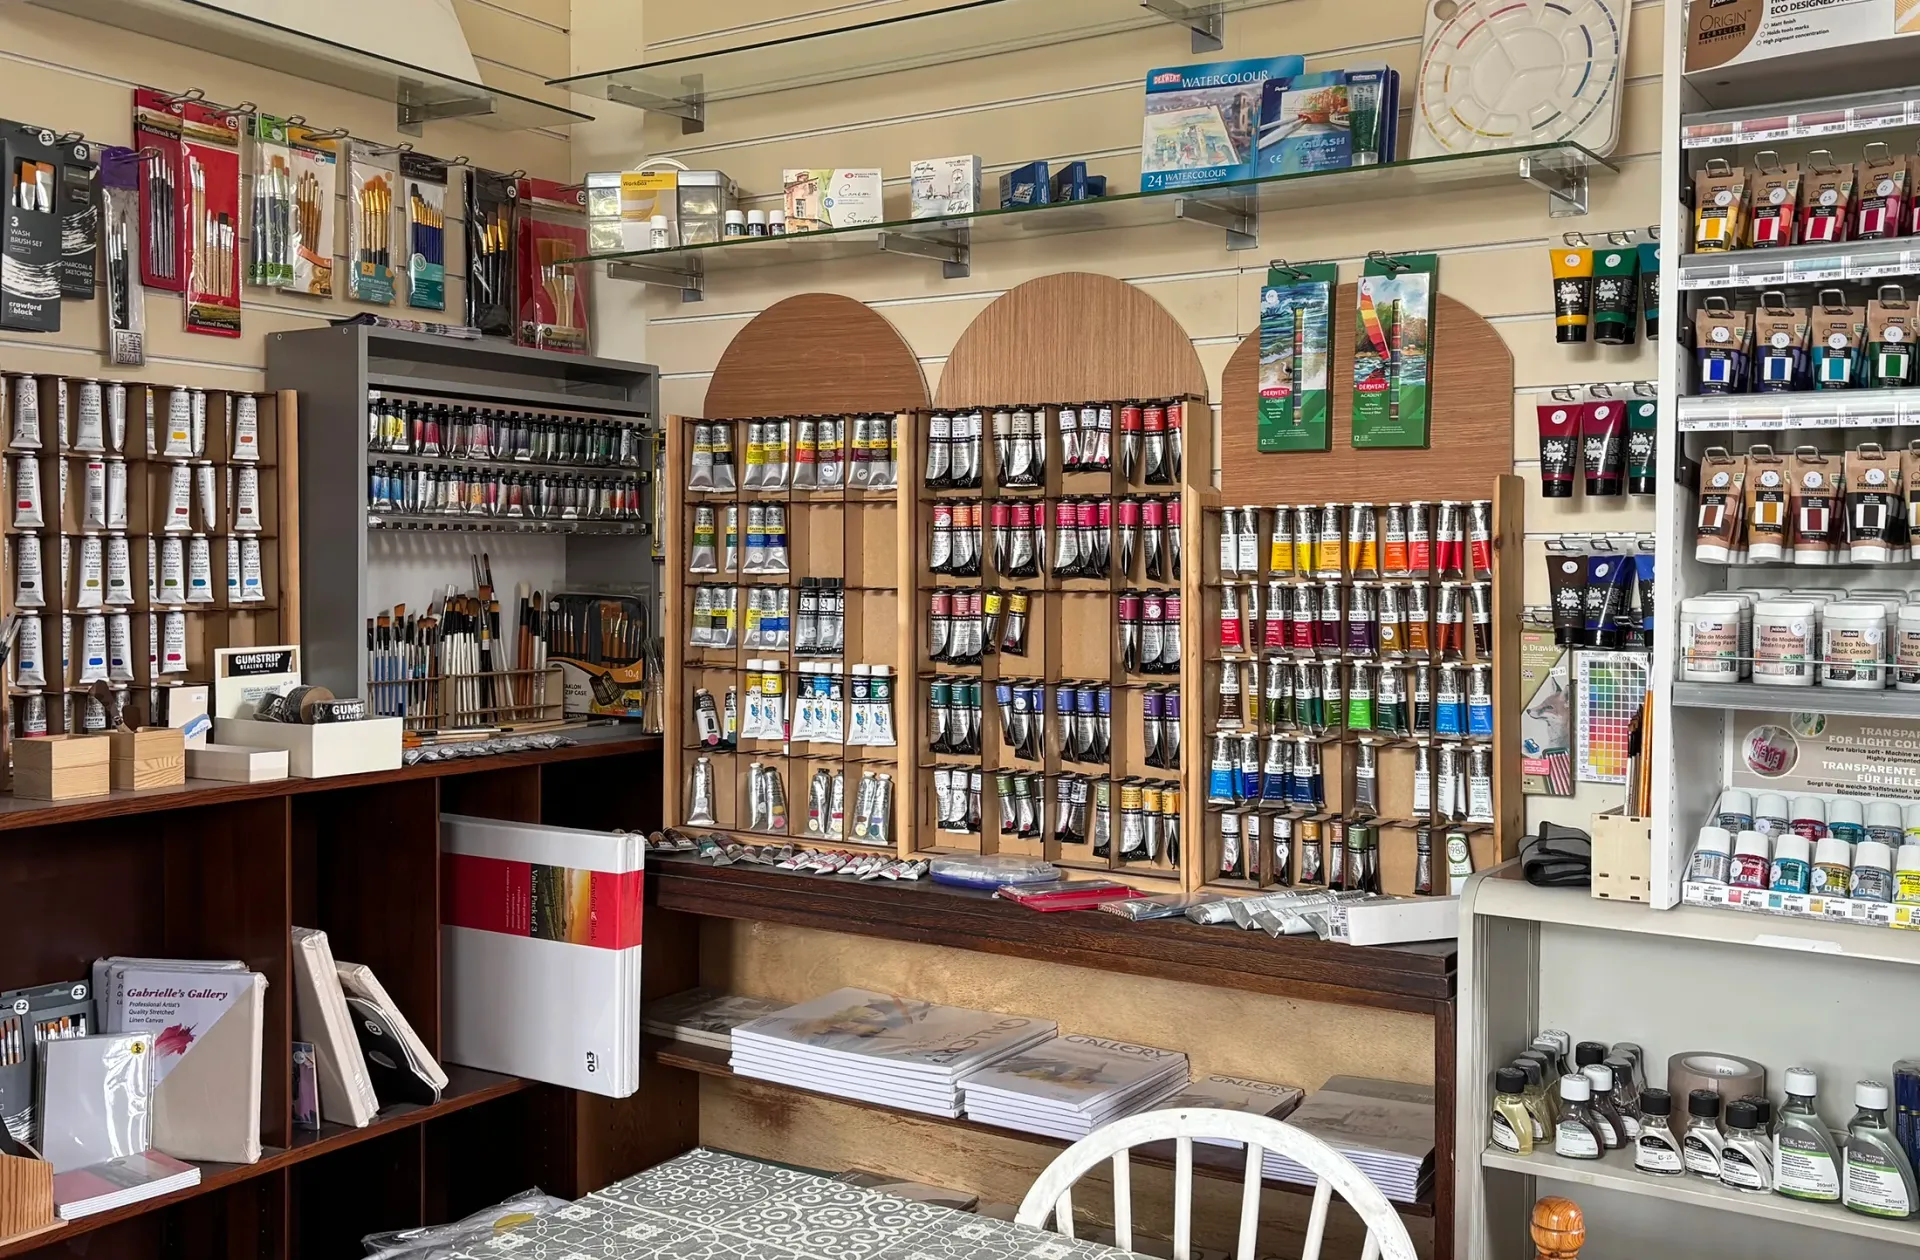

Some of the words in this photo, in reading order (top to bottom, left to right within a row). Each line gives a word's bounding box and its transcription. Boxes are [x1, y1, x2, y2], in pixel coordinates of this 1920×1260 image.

[1770, 4, 1789, 15] ECO
[1774, 34, 1795, 43] pigment
[1795, 29, 1829, 39] concentration
[1182, 70, 1269, 88] WATERCOLOUR
[41, 133, 53, 143] £3
[1147, 174, 1163, 188] 24
[1165, 168, 1227, 181] WATERCOLOUR
[11, 216, 19, 227] 3
[843, 211, 880, 224] Sonnet
[10, 229, 31, 237] WASH
[10, 236, 32, 246] BRUSH
[60, 260, 88, 270] CHARCOAL
[65, 268, 93, 277] SKETCHING
[9, 301, 42, 311] crawford
[1262, 388, 1289, 397] DERWENT
[1358, 383, 1387, 391] DERWENT
[235, 652, 281, 665] GUMSTRIP
[1829, 735, 1853, 744] FOR
[1856, 737, 1892, 748] LIGHT
[1867, 755, 1886, 763] Highly
[1885, 750, 1912, 758] Machine
[1822, 760, 1917, 777] TRANSPARENTE
[1807, 779, 1825, 788] Sorgt
[1857, 772, 1881, 784] FÜR
[531, 869, 539, 893] Value
[531, 916, 538, 924] of
[73, 988, 85, 996] £3
[127, 988, 185, 999] Gabrielle's
[187, 989, 228, 1001] Gallery
[16, 1003, 27, 1011] £2
[1064, 1034, 1175, 1059] GALLERY
[586, 1050, 596, 1073] £10
[1209, 1074, 1296, 1095] GALLERY
